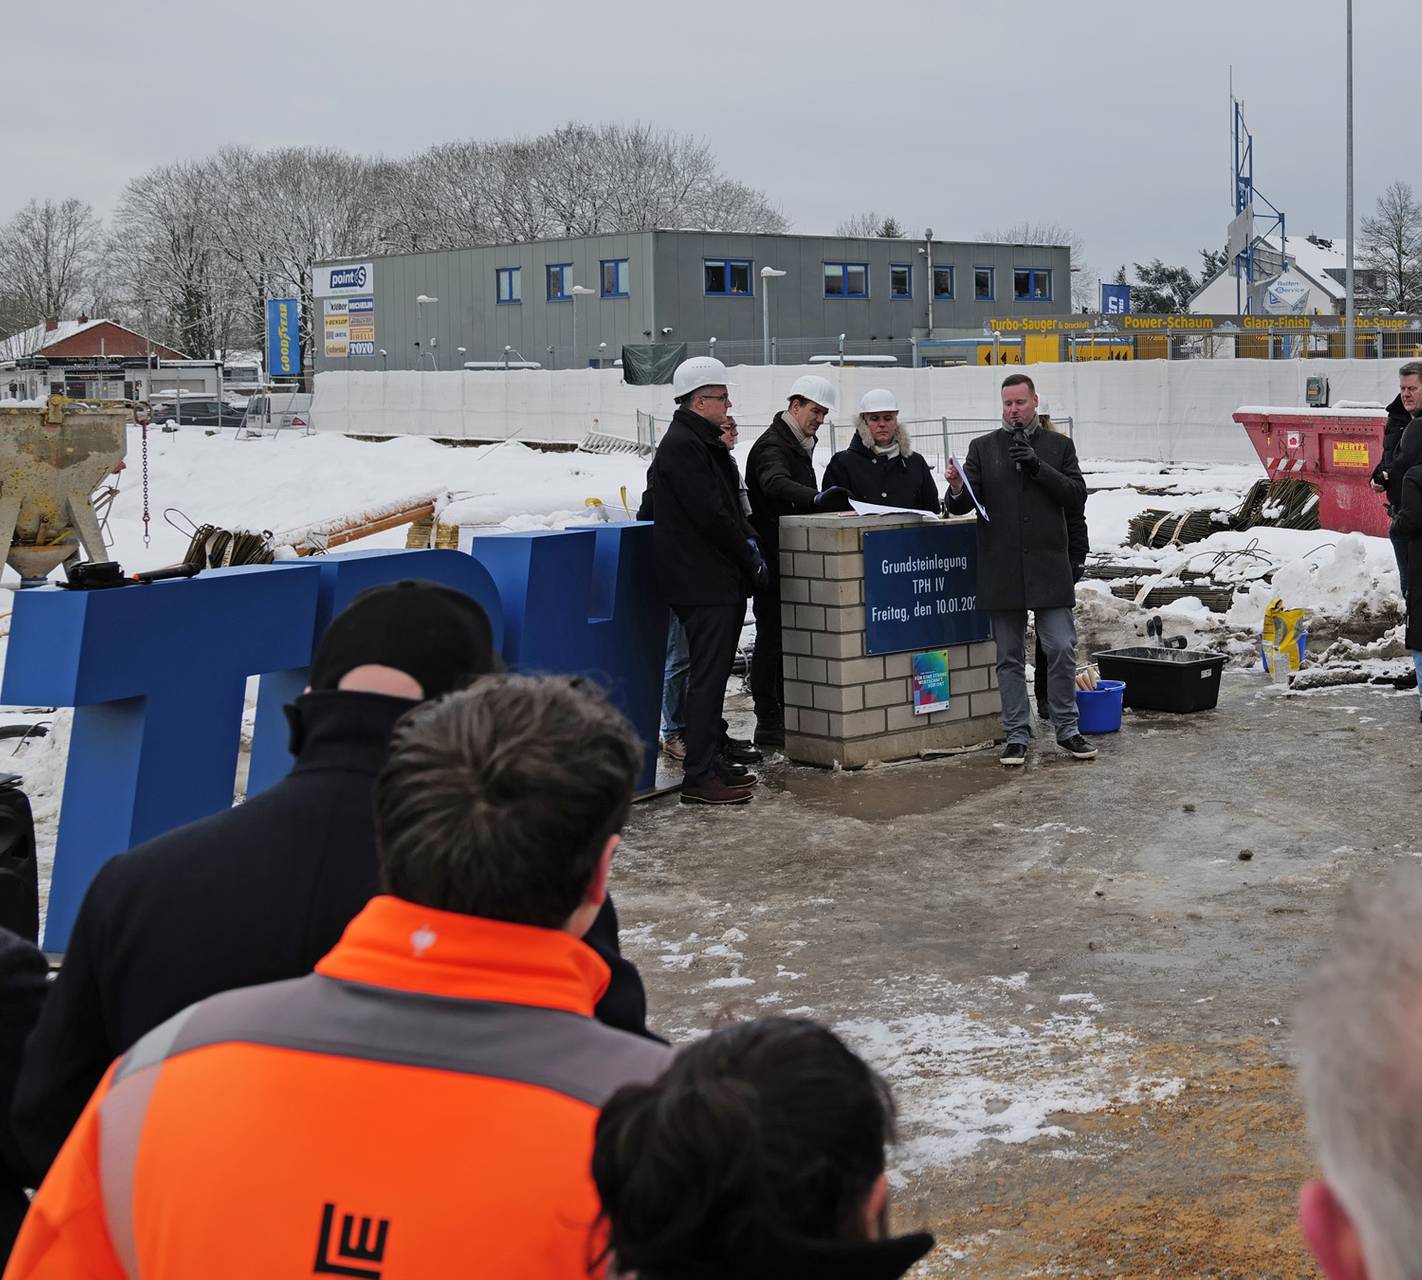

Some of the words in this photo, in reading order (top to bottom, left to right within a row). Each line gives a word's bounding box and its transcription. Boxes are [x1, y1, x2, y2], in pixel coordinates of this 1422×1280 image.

[332, 272, 354, 286] point
[358, 270, 366, 285] S
[991, 318, 1057, 332] Turbo-Sauger
[1123, 316, 1214, 329] Power-Schaum
[1243, 317, 1310, 329] Glanz-Finish
[1340, 317, 1408, 330] Trbo-Sauger
[278, 304, 291, 371] GOODYEAR
[350, 343, 374, 355] TOYO
[1337, 442, 1365, 450] WERTZ
[881, 554, 967, 575] Grundsteinlegung
[912, 578, 931, 594] TPH
[935, 577, 945, 591] IV
[872, 606, 910, 622] Freitag,
[914, 601, 932, 617] den
